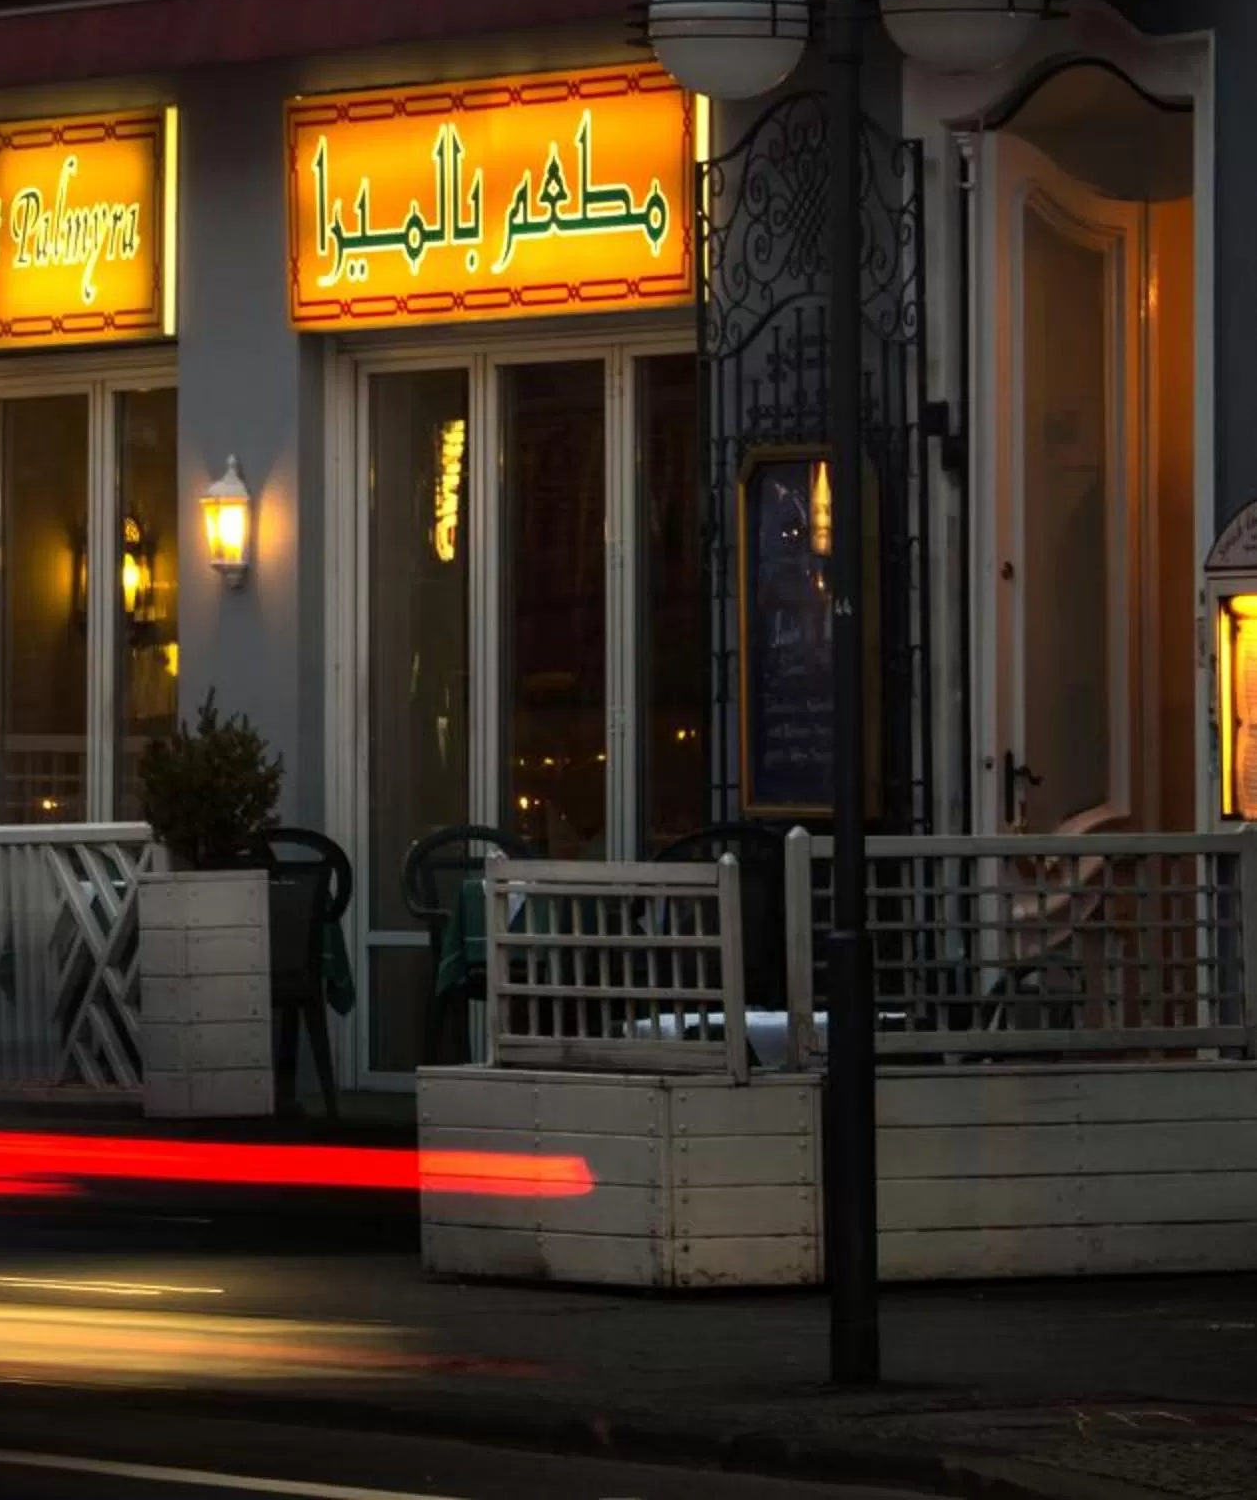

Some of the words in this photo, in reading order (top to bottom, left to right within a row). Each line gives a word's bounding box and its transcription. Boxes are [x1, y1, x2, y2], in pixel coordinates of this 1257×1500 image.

[10, 155, 140, 305] Palmyra
[313, 122, 484, 287] بالميرا
[491, 108, 670, 273] مطعم
